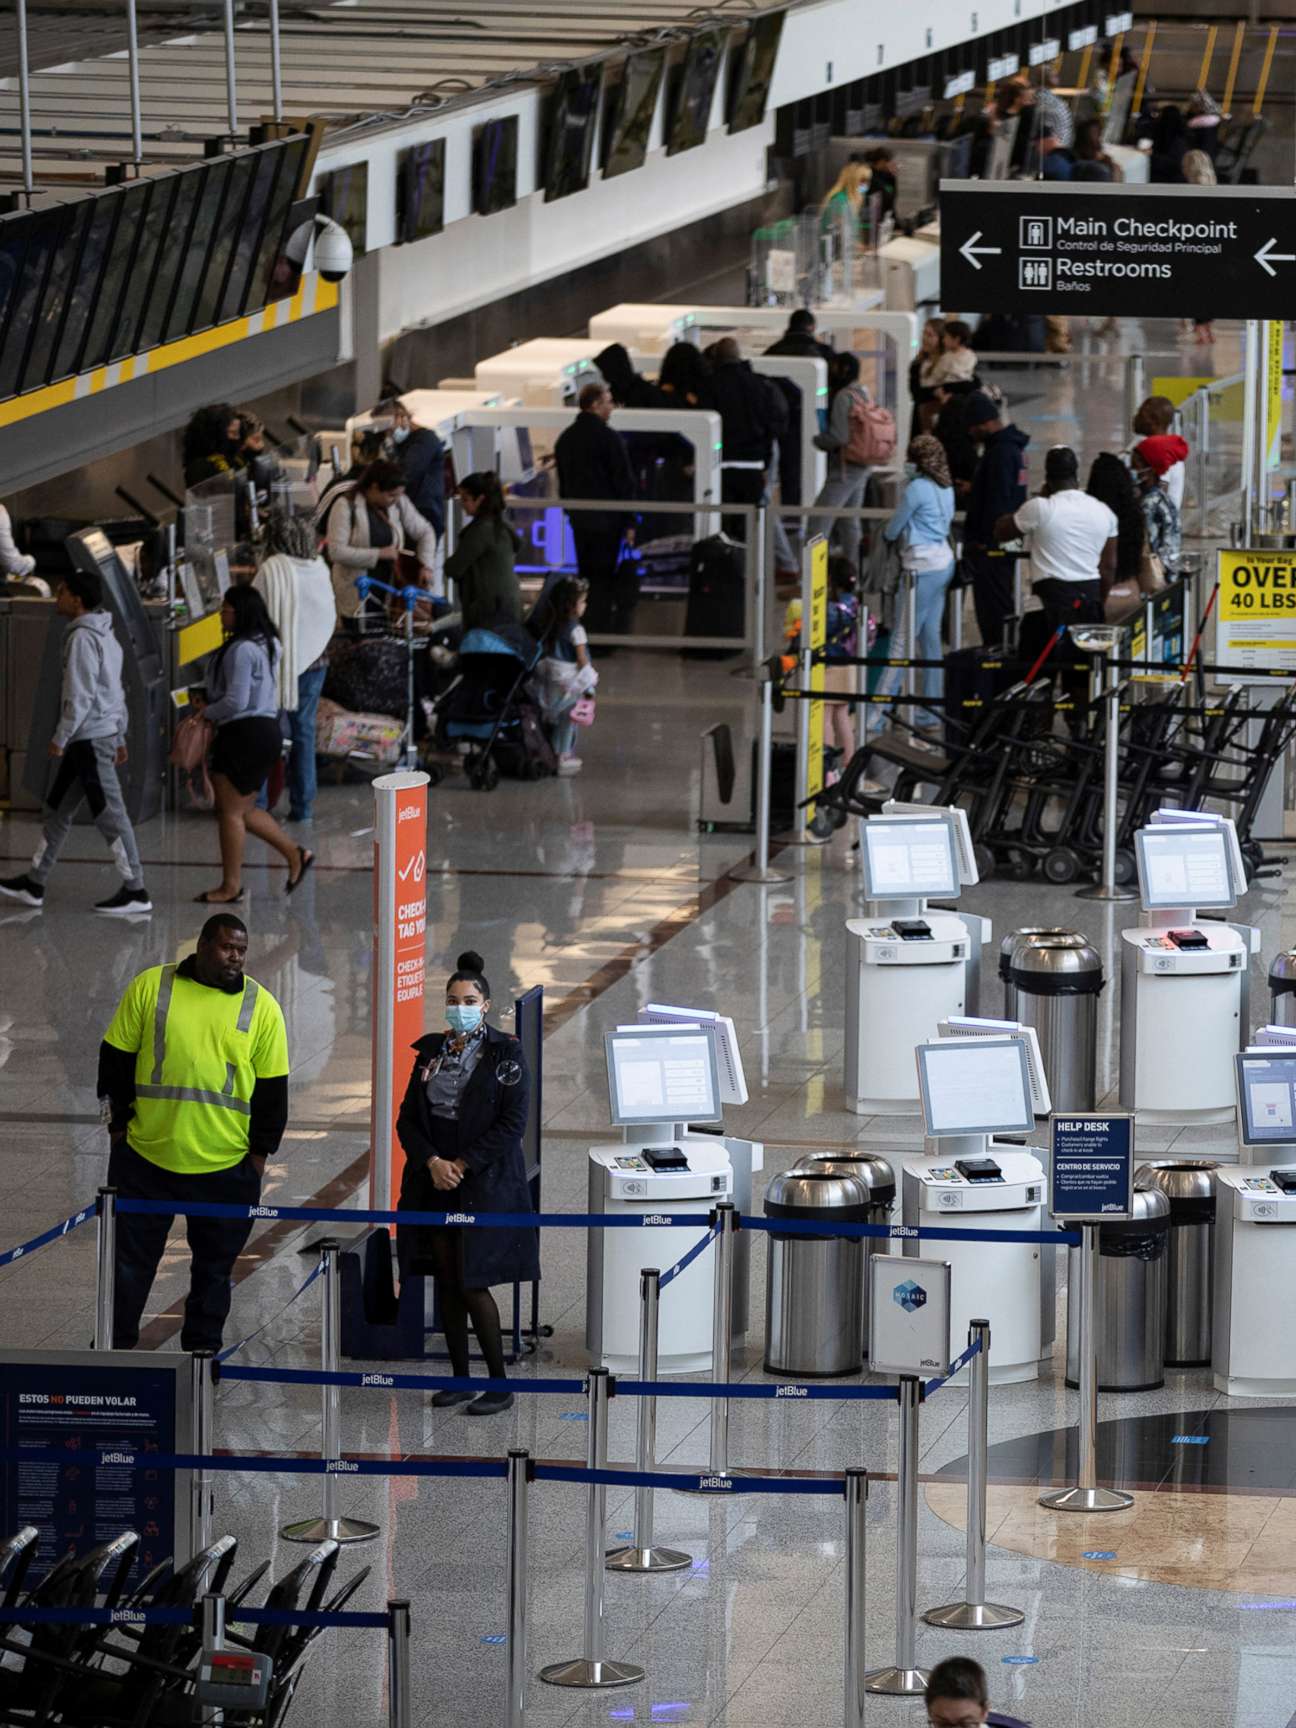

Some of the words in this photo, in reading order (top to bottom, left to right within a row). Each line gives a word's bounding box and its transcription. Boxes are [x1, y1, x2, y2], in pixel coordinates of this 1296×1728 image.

[1056, 218, 1107, 237] Main
[1114, 218, 1237, 243] Checkpoint
[1056, 240, 1098, 252] Control
[1100, 241, 1113, 252] de
[1115, 241, 1172, 255] Seguridad
[1174, 242, 1222, 256] Principal
[1056, 258, 1172, 279] Restrooms
[1056, 279, 1091, 292] Baños
[1256, 556, 1274, 564] Your
[1277, 556, 1293, 566] Bag
[1230, 592, 1255, 609] 40
[398, 806, 421, 824] jetBlue
[398, 922, 415, 940] TAG
[1057, 1122, 1082, 1132] HELP
[1084, 1122, 1110, 1132] DESK
[1056, 1163, 1082, 1171] CENTRO
[1083, 1163, 1091, 1171] DE
[1092, 1163, 1121, 1171] SERVICIO
[248, 1205, 278, 1218] jetBlue
[1101, 1203, 1124, 1212] jetBlue
[445, 1213, 475, 1224] jetBlue
[643, 1215, 672, 1226] jetBlue
[889, 1226, 919, 1237] jetBlue
[895, 1292, 925, 1300] MOSAIC
[920, 1359, 940, 1368] jetBlue
[361, 1374, 394, 1387] jetBlue
[776, 1385, 808, 1397] jetBlue
[19, 1394, 49, 1404] ESTOS
[50, 1395, 65, 1404] NO
[66, 1396, 104, 1406] PUEDEN
[105, 1397, 136, 1406] VOLAR
[101, 1452, 135, 1464] jetBlue
[325, 1461, 359, 1473] jetBlue
[699, 1477, 732, 1489] jetBlue
[110, 1609, 146, 1622] jetBlue
